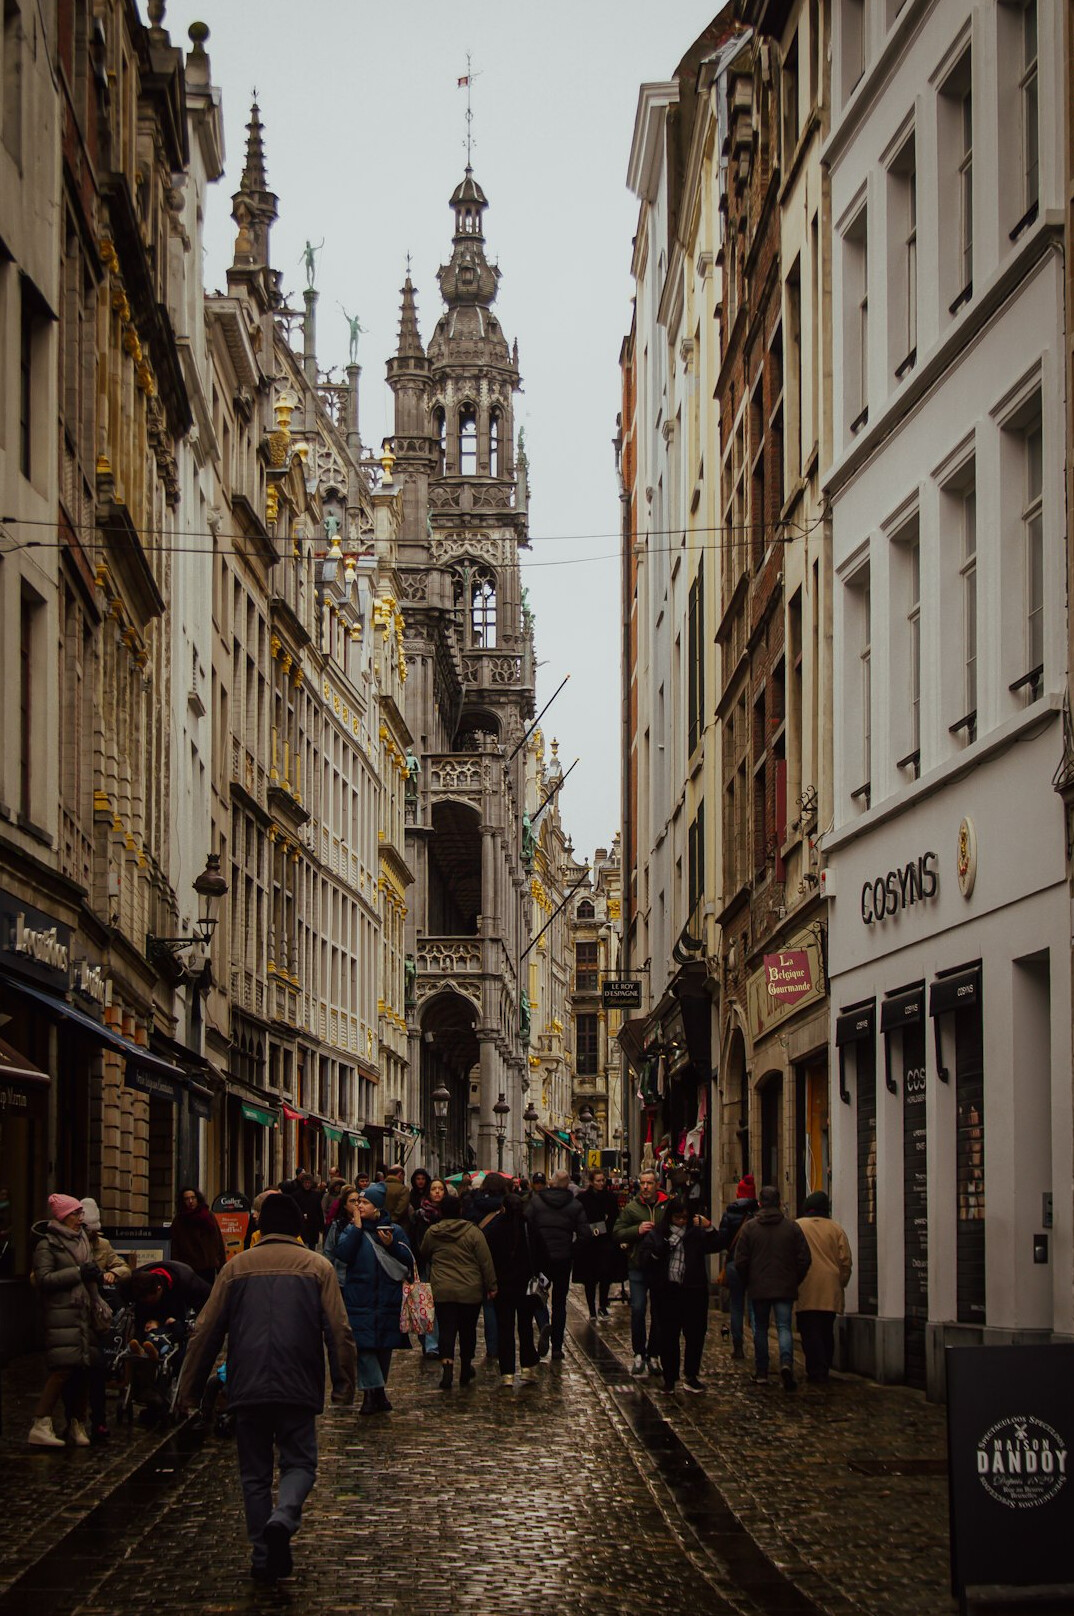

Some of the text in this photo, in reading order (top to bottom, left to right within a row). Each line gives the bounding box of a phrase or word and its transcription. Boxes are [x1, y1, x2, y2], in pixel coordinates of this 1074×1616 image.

[861, 851, 938, 925] COSYNS
[779, 955, 794, 966] La
[768, 966, 805, 982] Belgique
[767, 980, 811, 998] Gourmande
[591, 1154, 597, 1167] 2
[115, 1229, 153, 1237] Leonidas
[993, 1438, 1050, 1452] MAISON
[977, 1450, 1068, 1474] DANDOY
